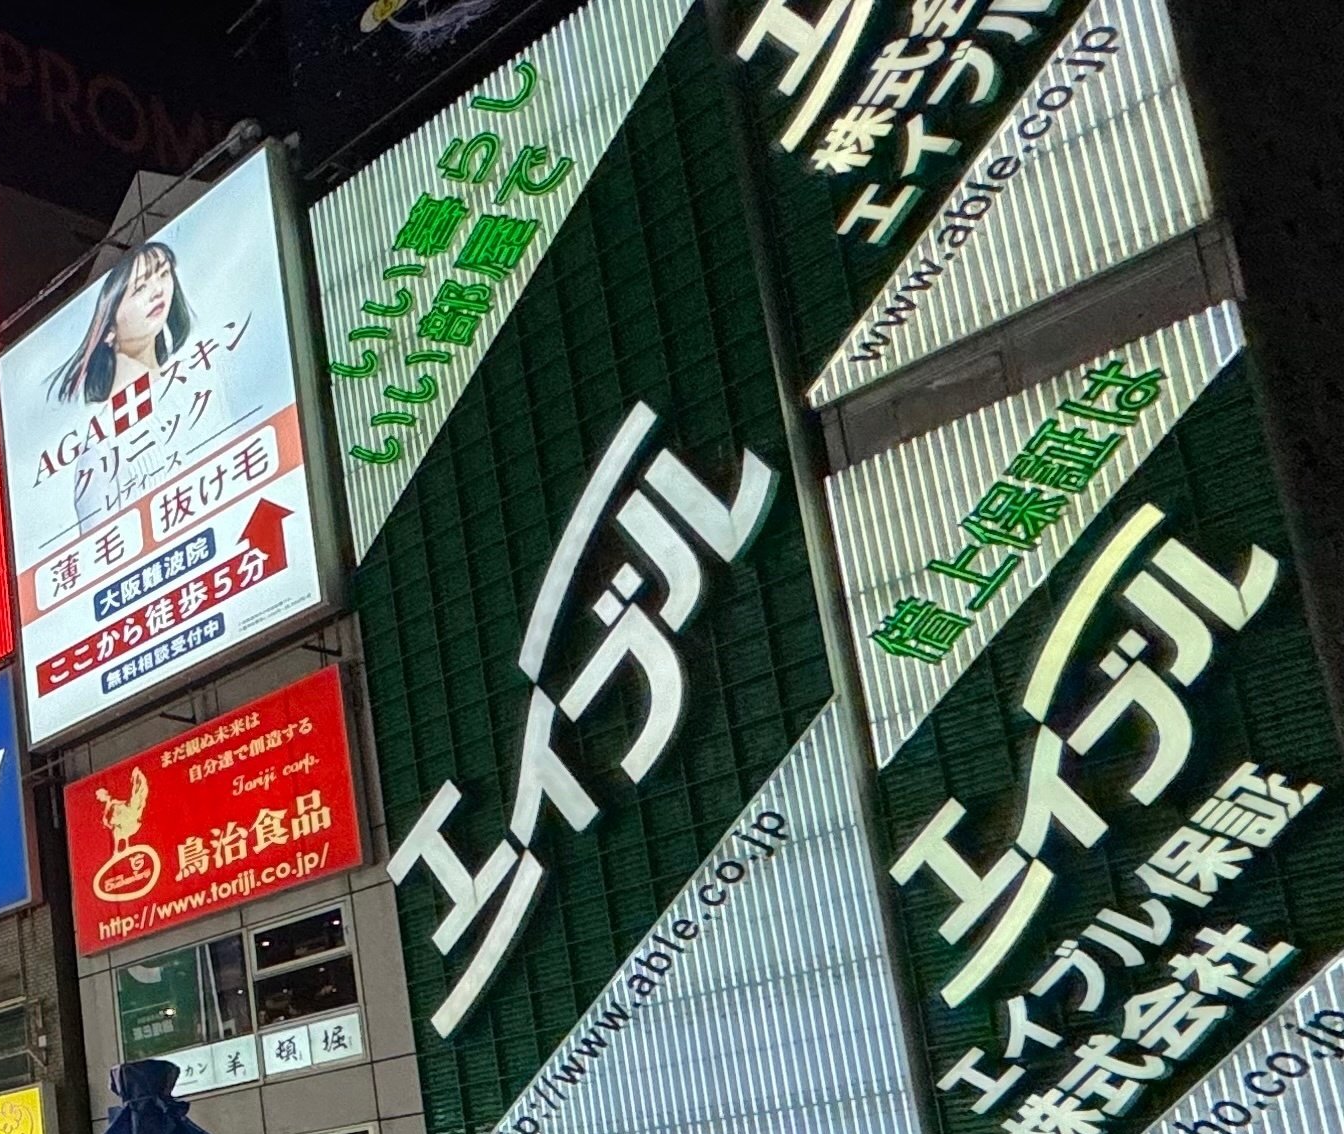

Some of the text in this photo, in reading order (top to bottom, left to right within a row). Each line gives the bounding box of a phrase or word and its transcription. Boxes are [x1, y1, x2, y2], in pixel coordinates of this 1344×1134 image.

[329, 59, 538, 378] いい暮らし
[850, 24, 1119, 363] www.able.co.jp
[349, 144, 575, 464] いい部屋で
[33, 311, 253, 488] AGA スキン
[73, 388, 213, 502] クリニック
[105, 450, 183, 511] レディース
[159, 437, 271, 535] 抜け毛
[48, 546, 271, 686] ここから徒歩5分
[49, 531, 127, 598] 薄毛
[99, 533, 211, 619] 大阪難波院
[105, 619, 220, 691] 無料相談受付中
[385, 400, 778, 1039] エイブル
[889, 502, 1279, 1009] エイブル
[98, 842, 329, 940] http://www.toriji.co.jp/
[175, 789, 332, 882] 鳥治食品
[936, 760, 1323, 1116] エイブル保証
